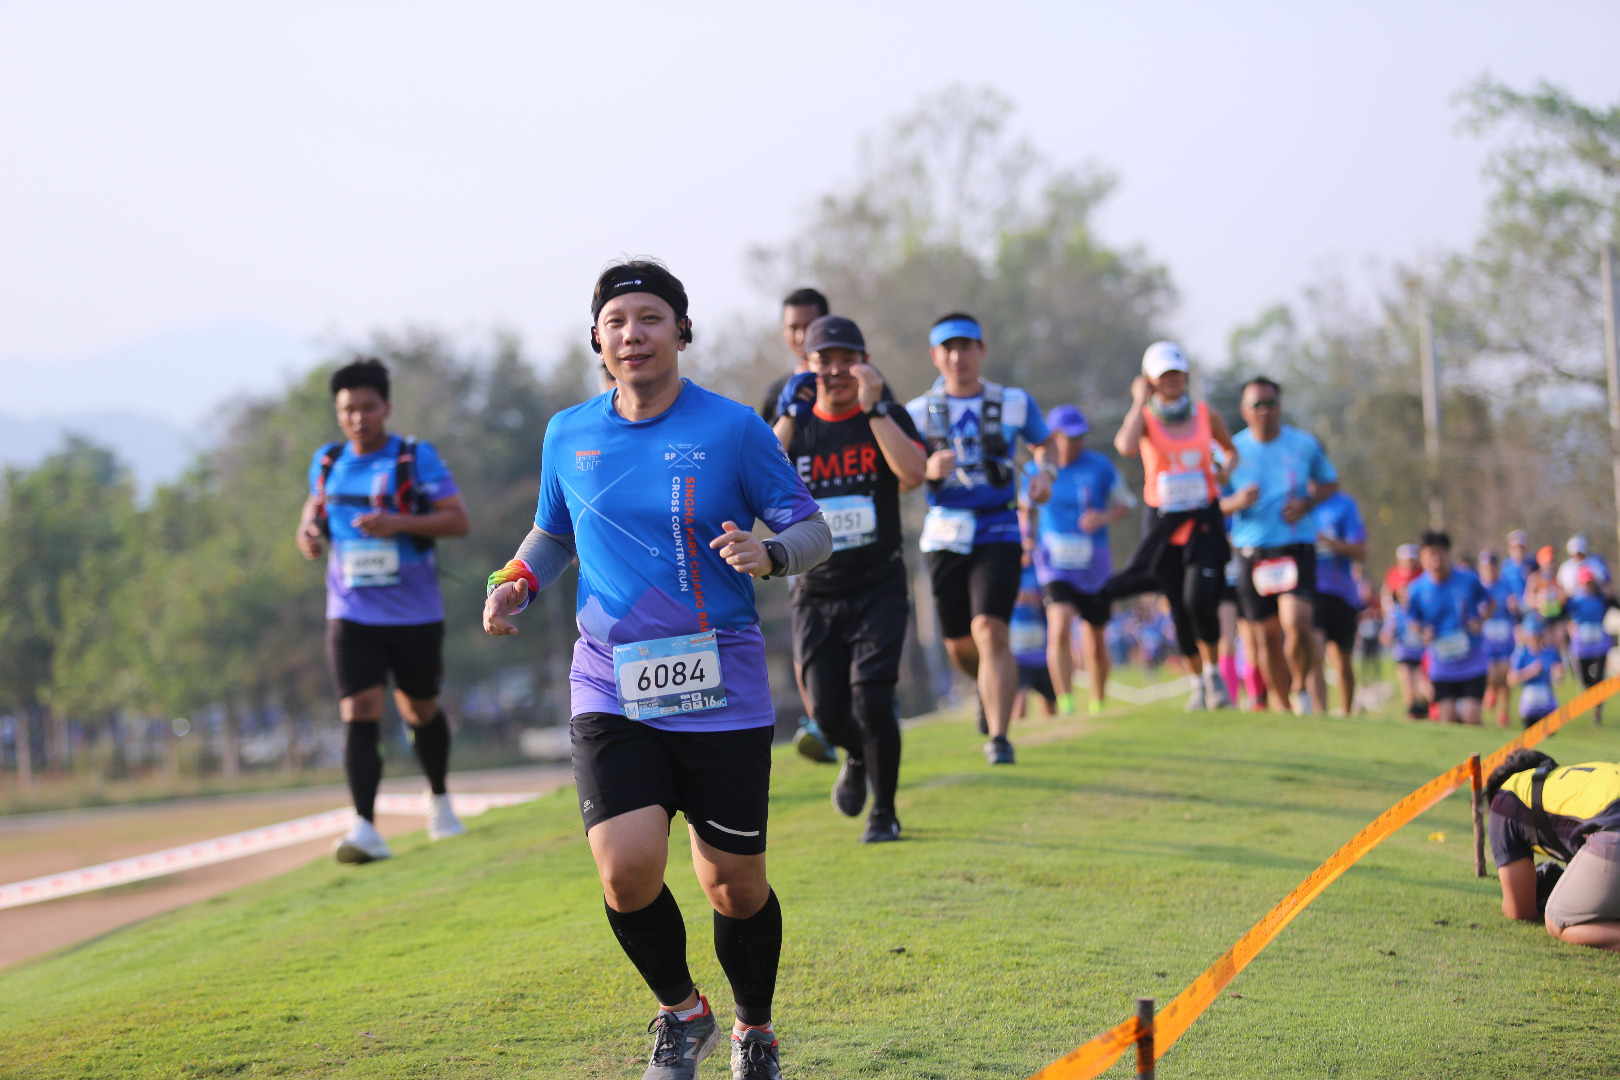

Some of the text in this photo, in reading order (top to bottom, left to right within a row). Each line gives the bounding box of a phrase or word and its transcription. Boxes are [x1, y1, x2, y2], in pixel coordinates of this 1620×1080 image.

[664, 452, 676, 460] SP
[692, 452, 705, 460] XC
[810, 473, 878, 490] UNNING
[684, 476, 696, 524] SINGHA
[825, 512, 861, 532] 051
[671, 476, 689, 592] CROSS COUNTRY RUN
[685, 527, 698, 558] PARK
[690, 561, 706, 609] CHIANG
[697, 612, 710, 632] RAI
[637, 658, 706, 691] 6084
[627, 705, 638, 718] M
[703, 695, 716, 708] 16
